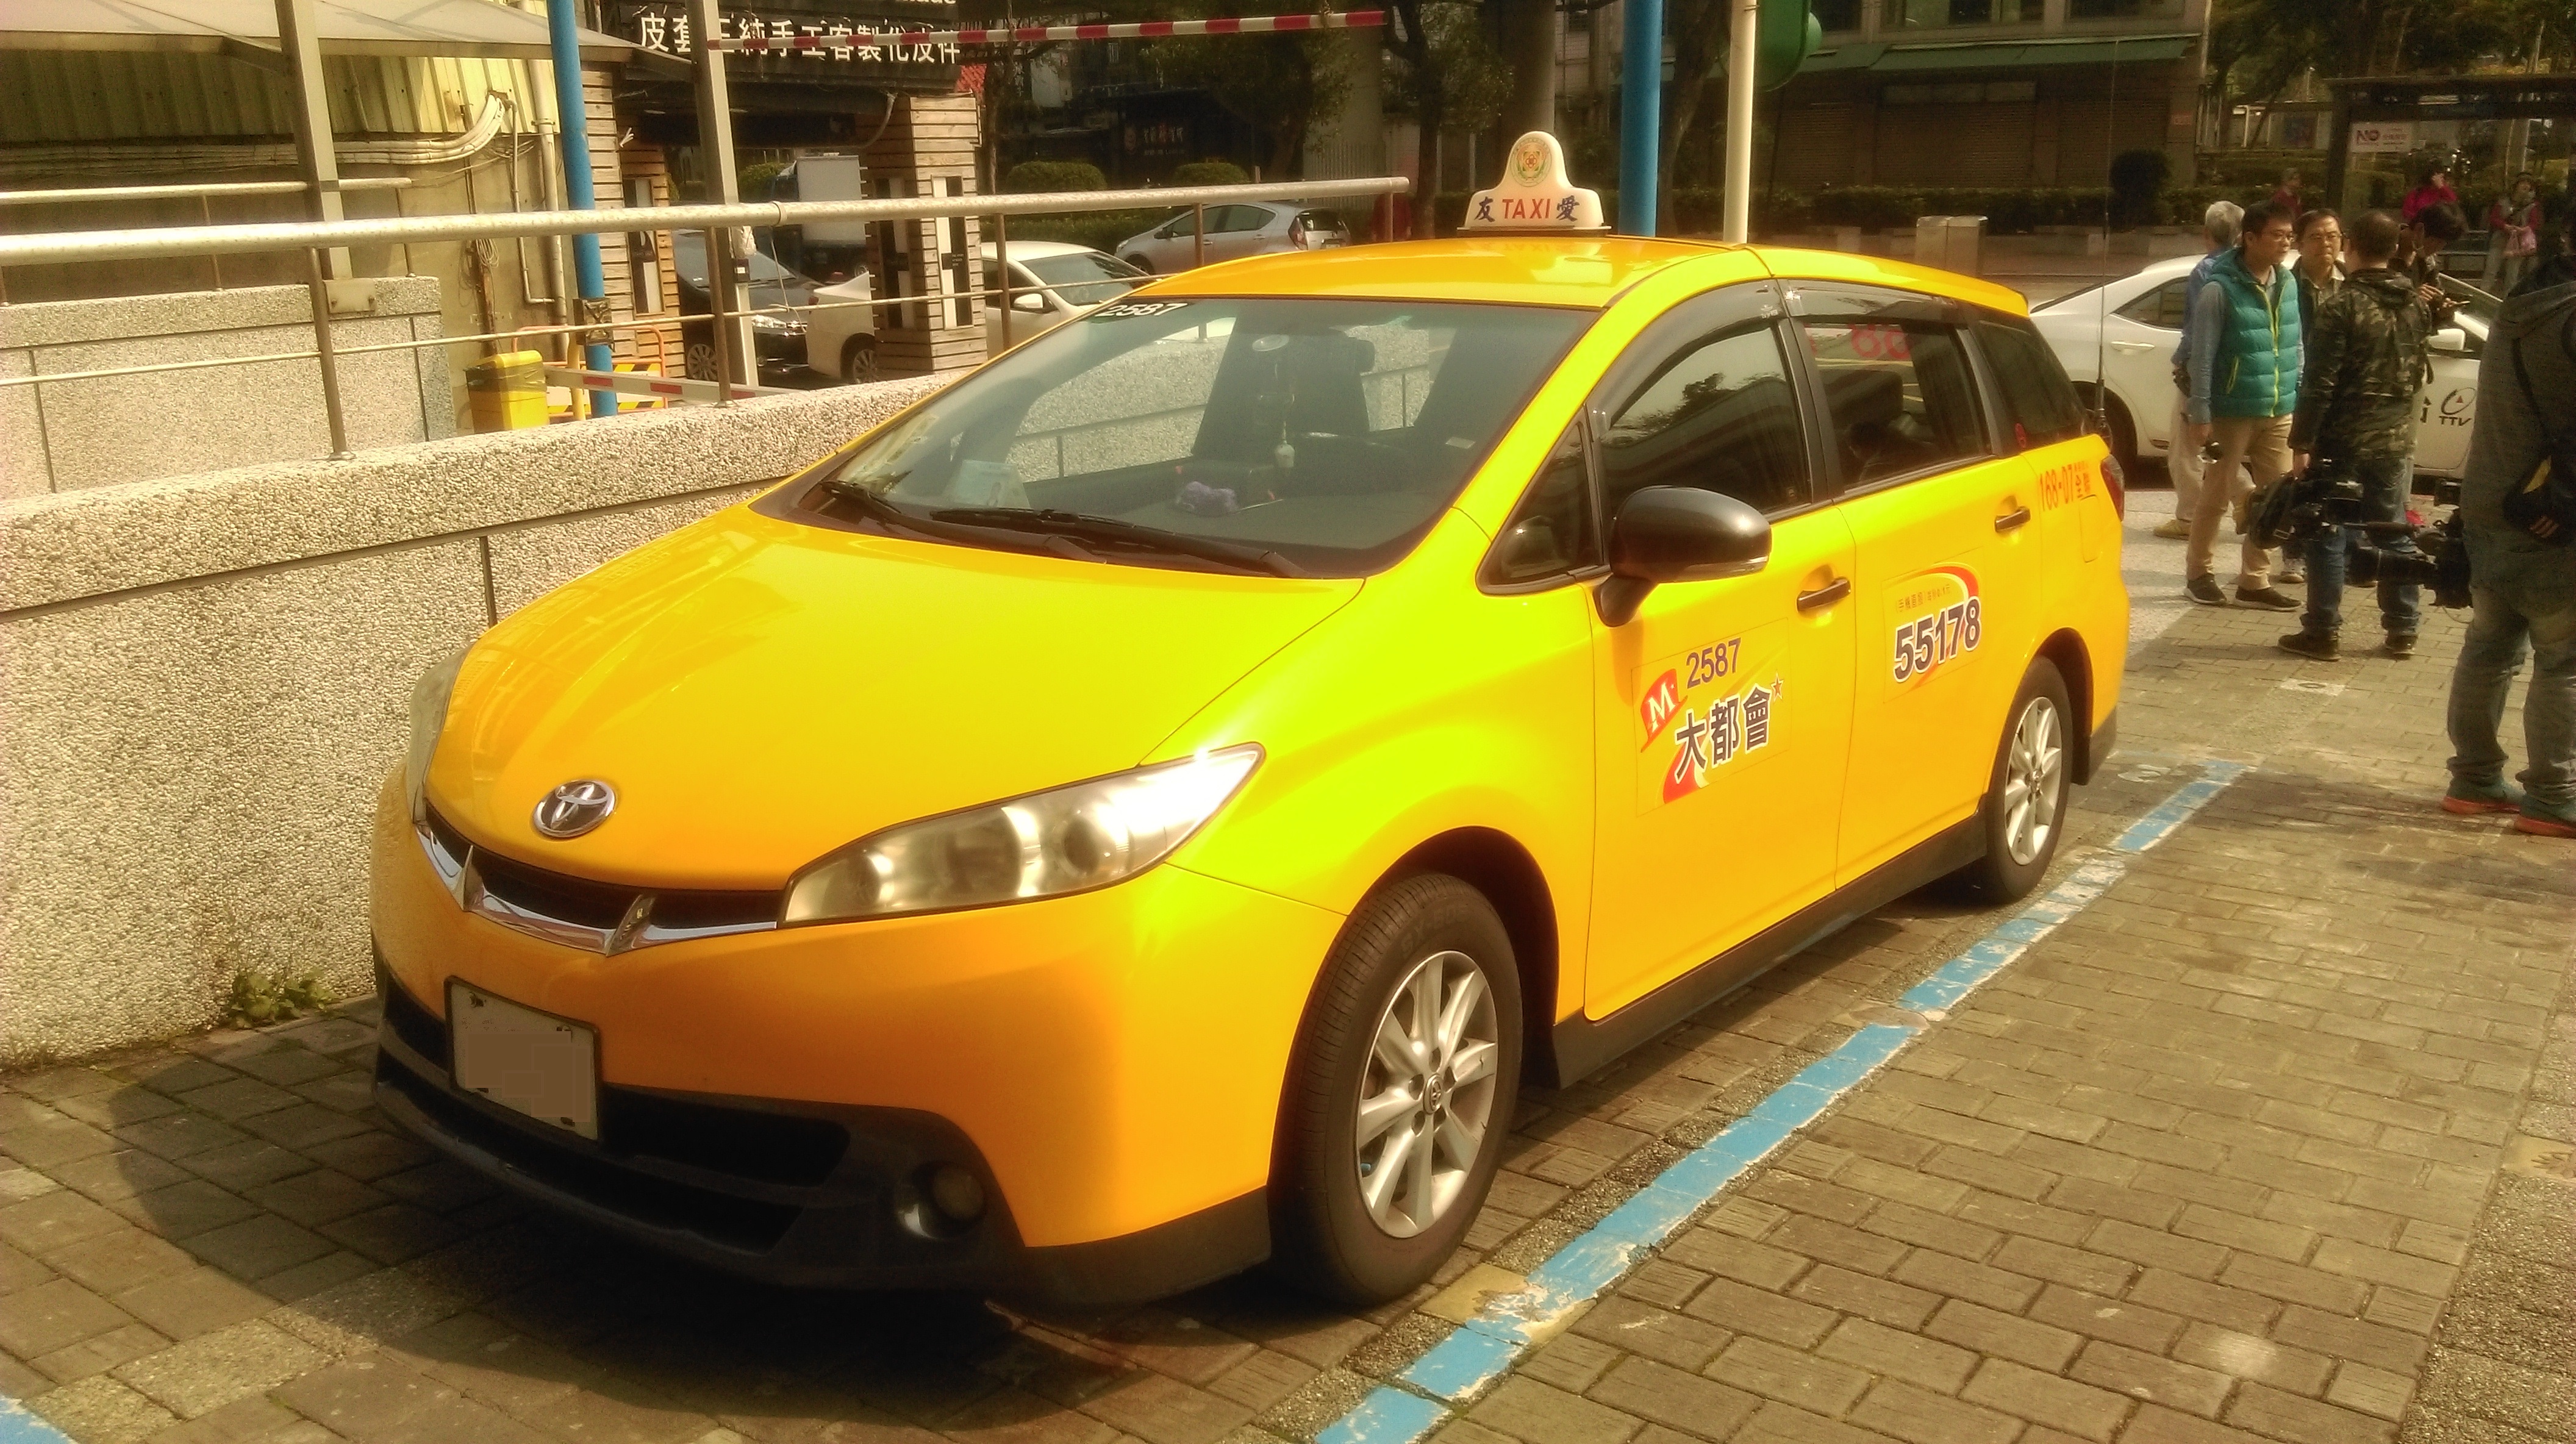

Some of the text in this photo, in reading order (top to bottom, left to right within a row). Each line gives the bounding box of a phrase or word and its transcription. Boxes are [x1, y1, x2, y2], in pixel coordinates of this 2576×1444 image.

[1474, 196, 1495, 223] 友
[1502, 198, 1551, 220] TAXI
[1556, 195, 1580, 222] 愛
[1095, 302, 1189, 317] 2587
[2439, 415, 2472, 426] TTV
[1894, 595, 1981, 683] 55178
[1686, 637, 1742, 690] 2587
[1648, 682, 1676, 733] M
[1674, 682, 1773, 784] 大都會
